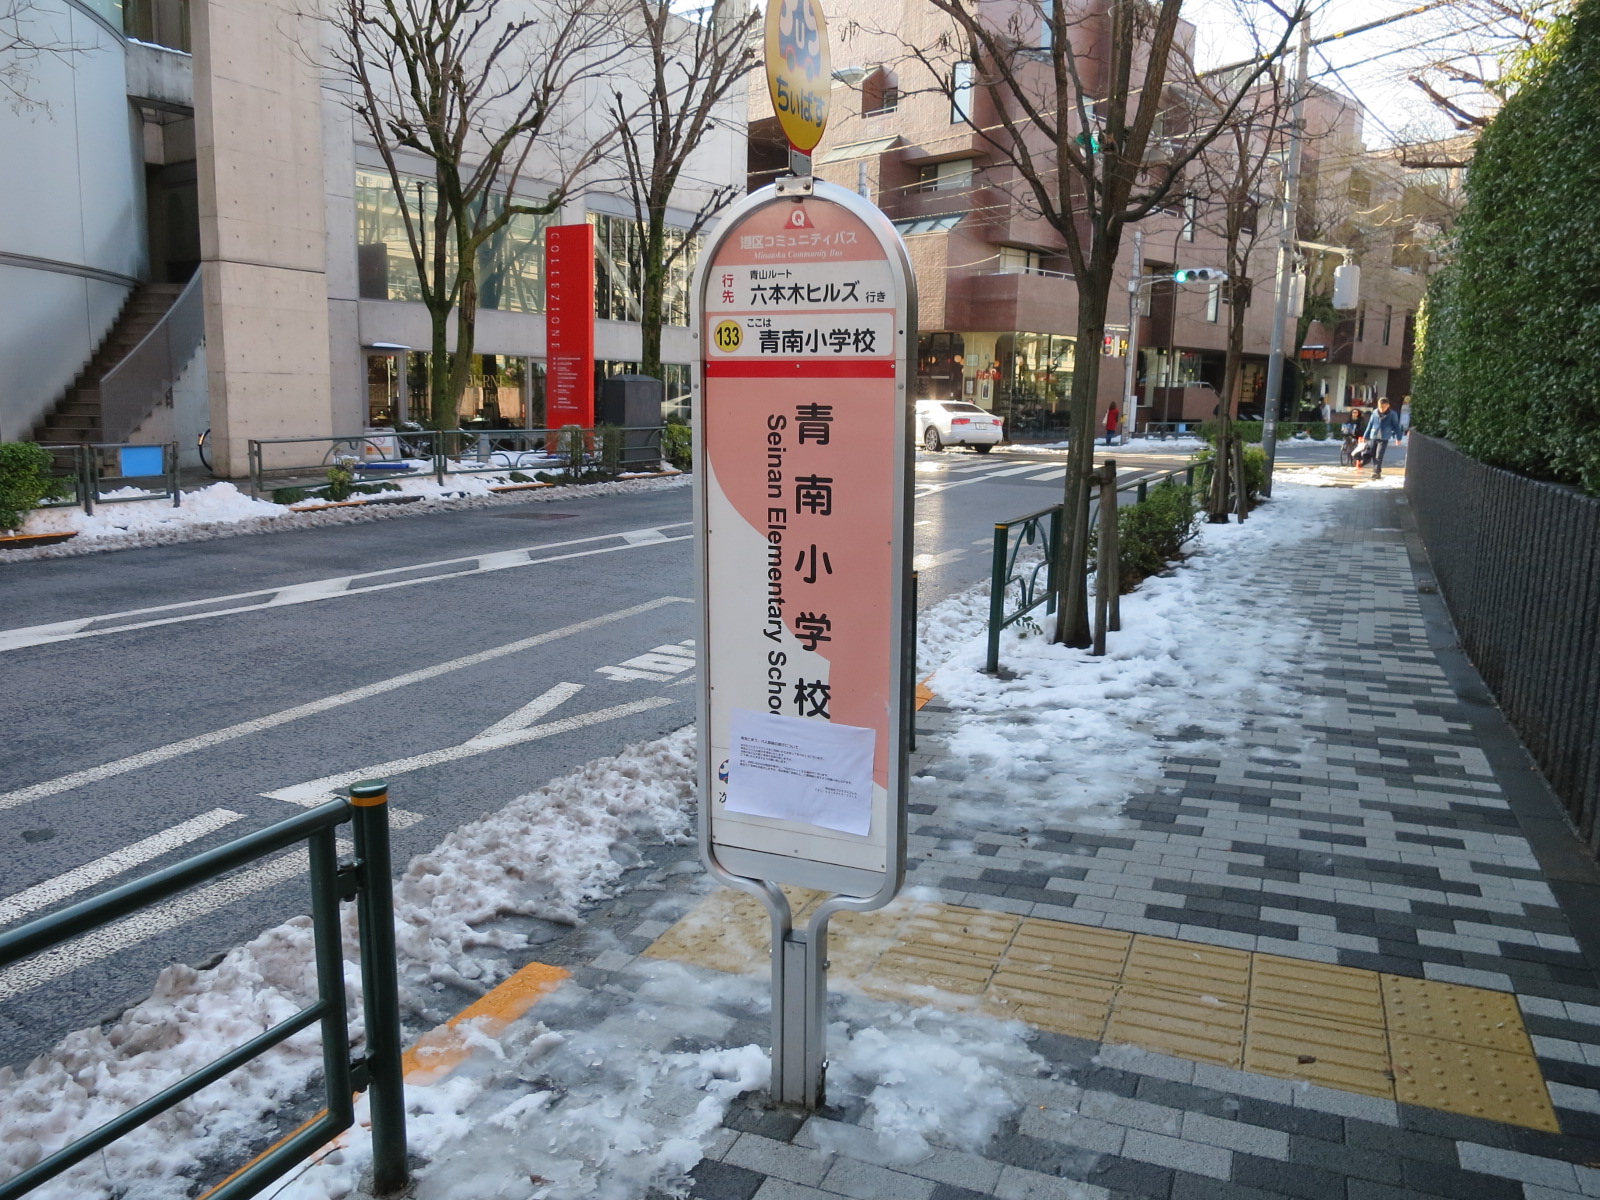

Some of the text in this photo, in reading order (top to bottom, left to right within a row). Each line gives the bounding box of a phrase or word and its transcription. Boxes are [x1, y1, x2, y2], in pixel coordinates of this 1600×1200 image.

[791, 211, 805, 226] Q
[740, 232, 858, 250] 港区コミュニティバス
[750, 269, 792, 280] 青山ルート
[550, 232, 561, 349] COLLEZIONE
[722, 274, 734, 303] 行先
[750, 280, 886, 305] 六本木ヒルズ 行き
[747, 318, 772, 328] ここは
[716, 326, 740, 347] 133
[759, 328, 876, 353] 青南小学校
[763, 414, 787, 715] Seinan Elementary Scho
[794, 402, 834, 719] 青南小学校
